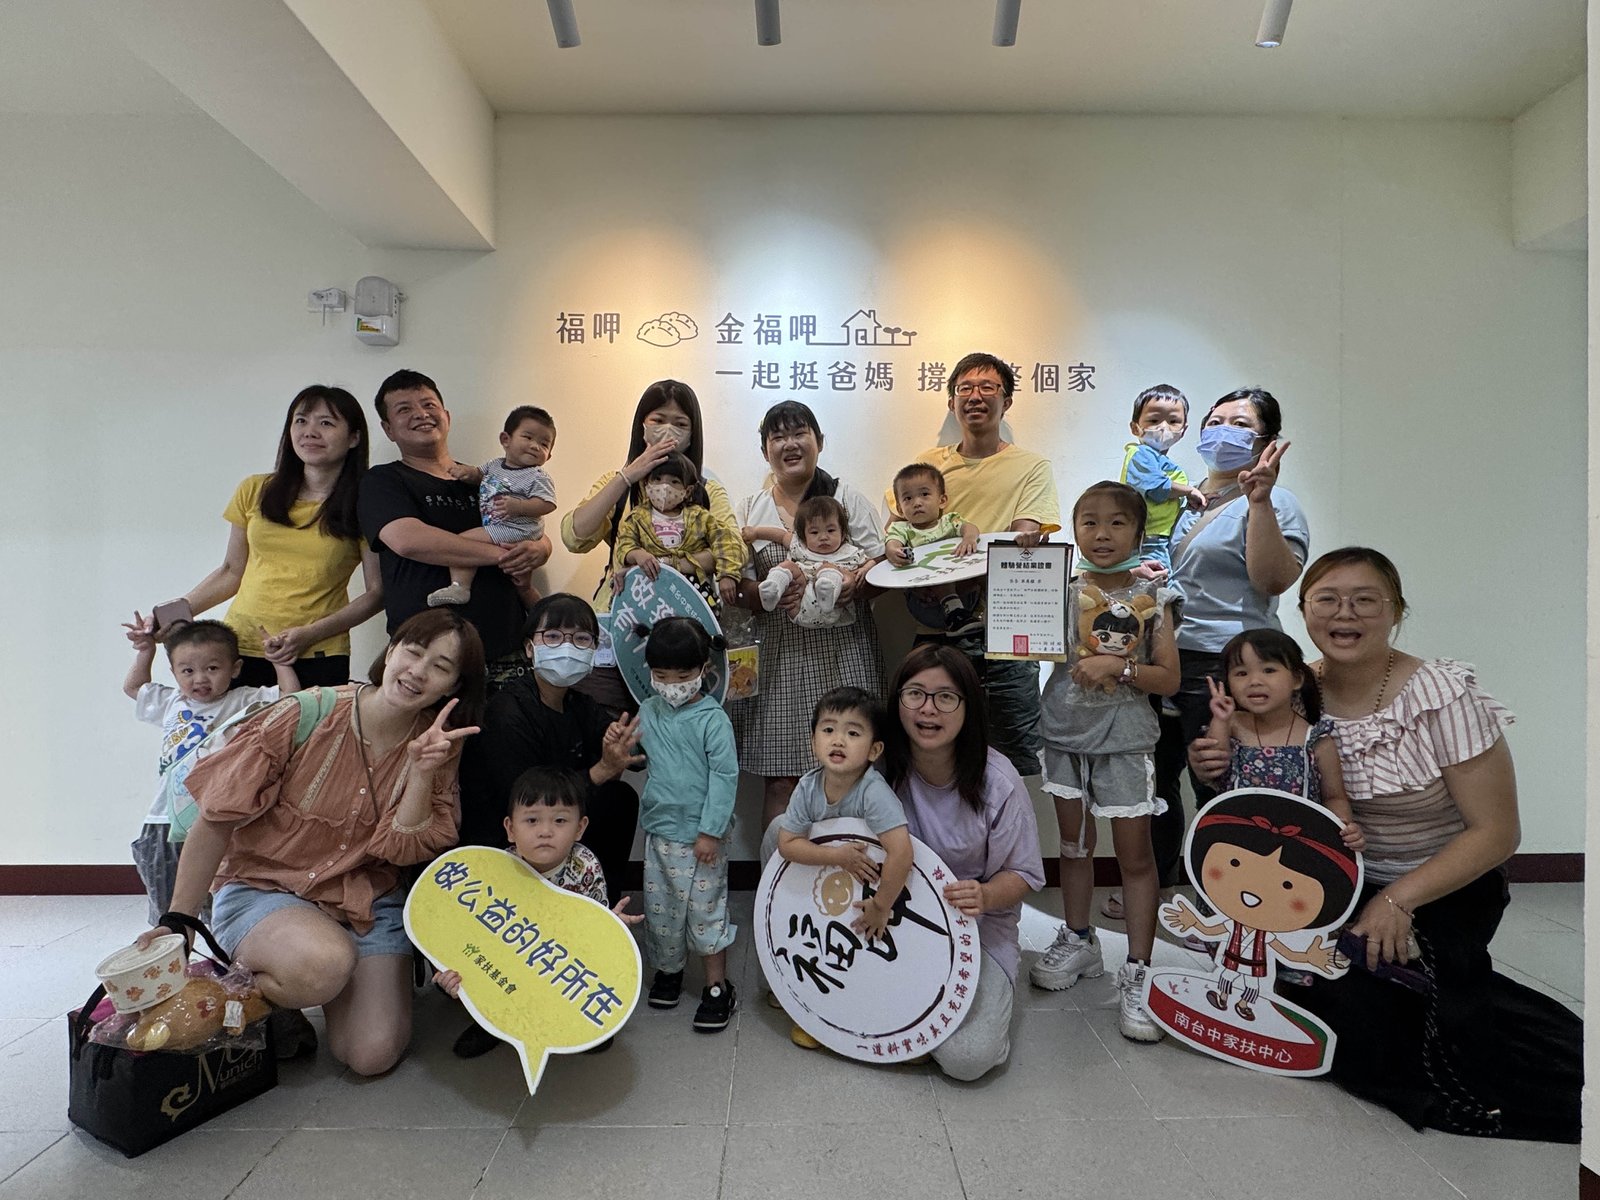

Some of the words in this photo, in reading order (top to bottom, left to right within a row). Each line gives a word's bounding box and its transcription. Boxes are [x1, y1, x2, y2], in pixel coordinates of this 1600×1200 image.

[556, 311, 621, 344] 福呷
[715, 312, 817, 345] 金福呷
[715, 360, 894, 392] 一起挺爸媽
[917, 361, 1097, 392] 撐個家
[434, 861, 622, 1026] 做公益的好所在
[474, 955, 517, 995] 家扶基金會
[1174, 1010, 1293, 1064] 南台中家扶中心
